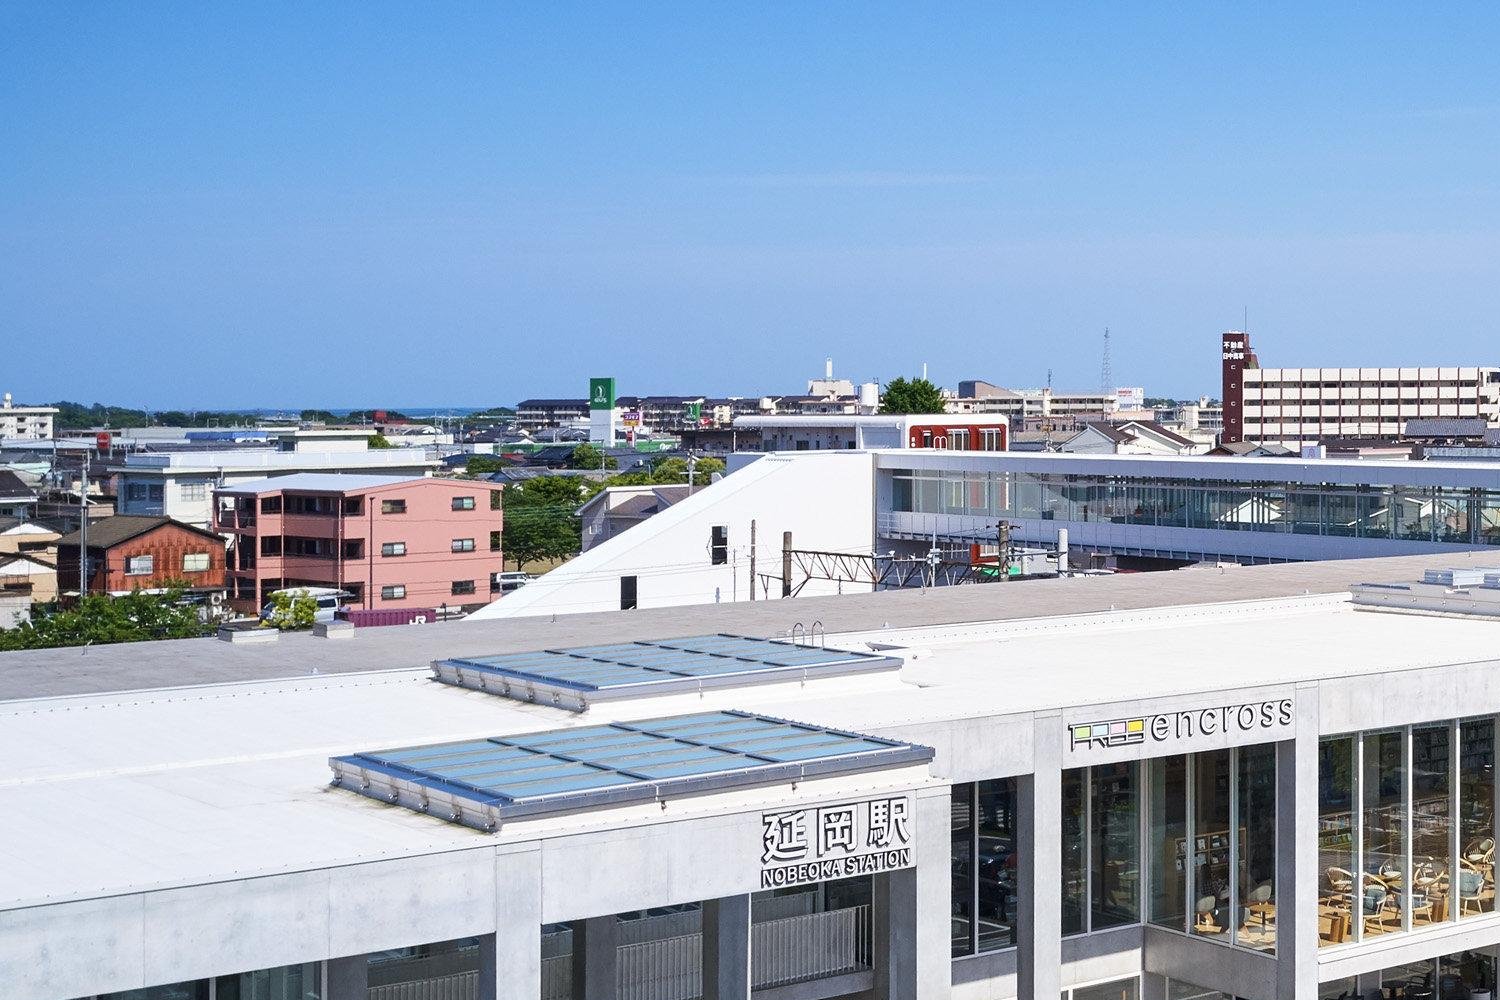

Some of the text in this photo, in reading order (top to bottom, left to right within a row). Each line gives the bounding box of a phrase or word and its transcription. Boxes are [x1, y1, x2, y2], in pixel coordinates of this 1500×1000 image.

[409, 615, 427, 626] JR
[1151, 699, 1294, 741] encross
[761, 796, 911, 864] 延岡駅
[761, 848, 911, 888] NOBEOKA STATION
